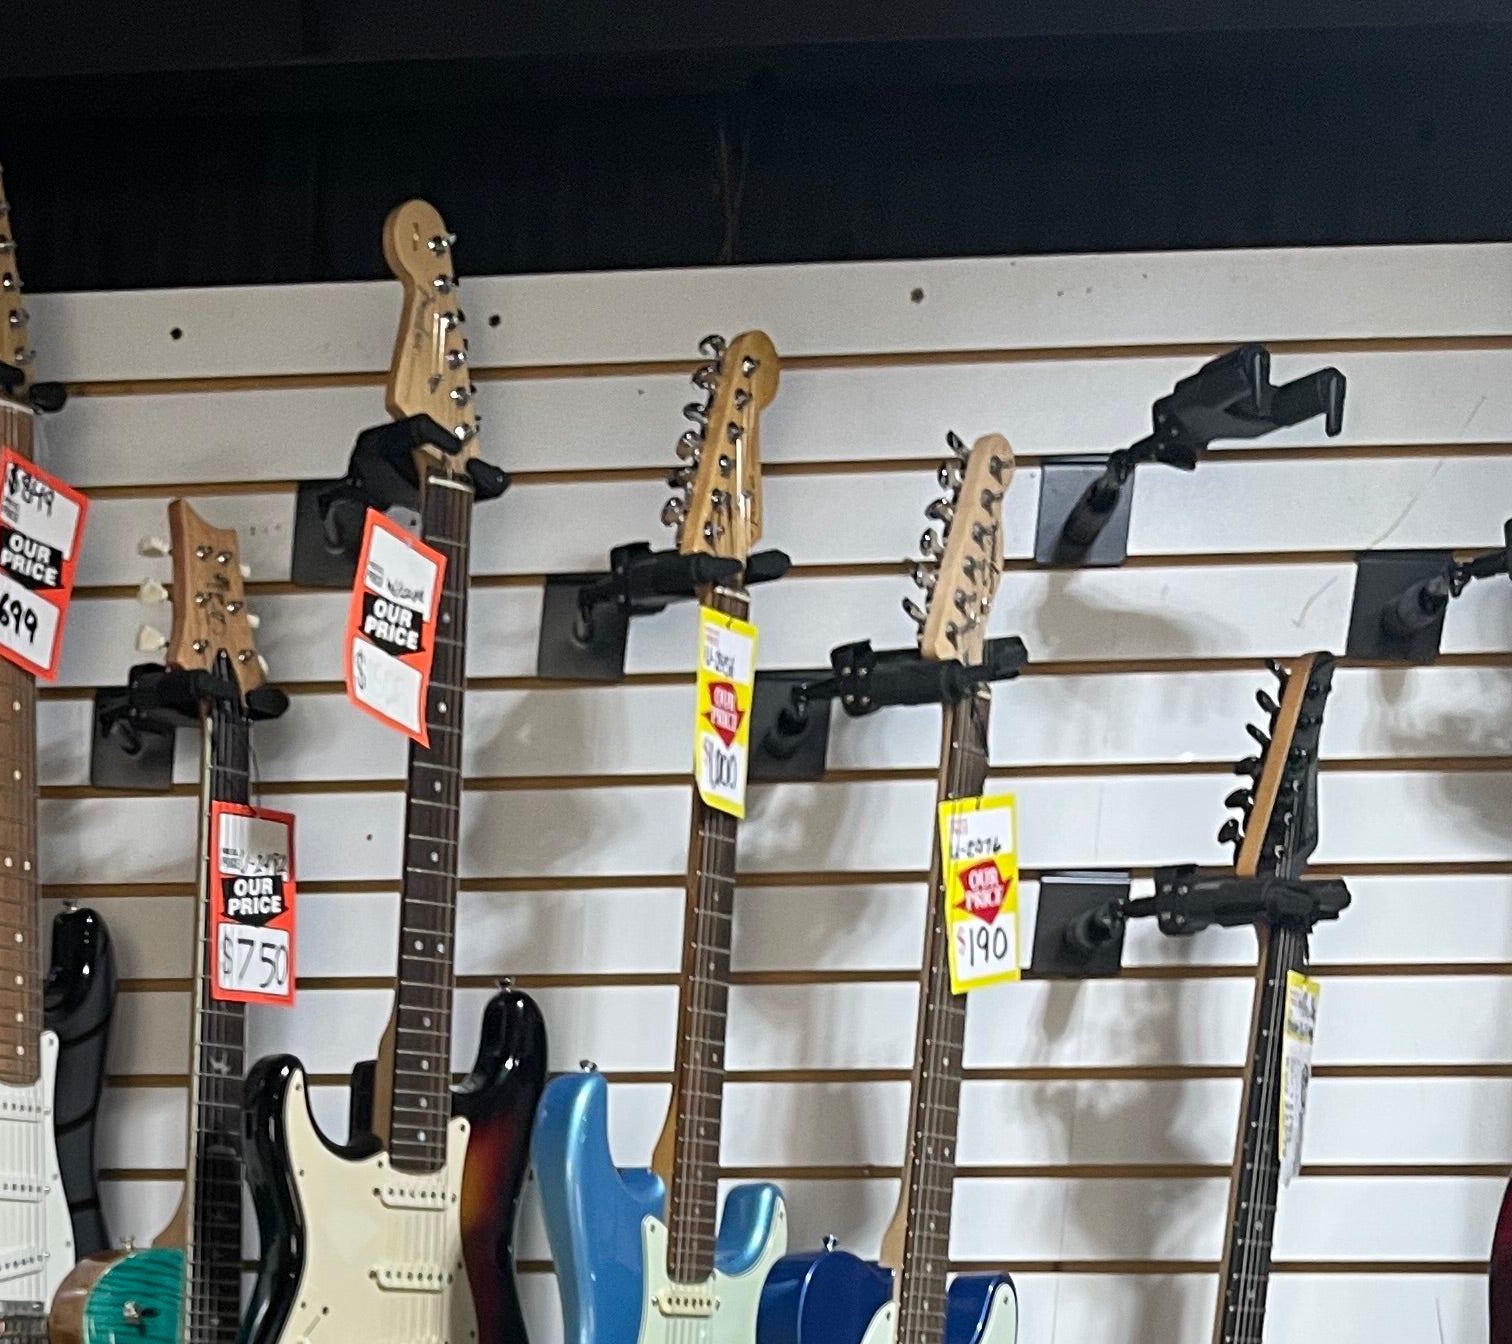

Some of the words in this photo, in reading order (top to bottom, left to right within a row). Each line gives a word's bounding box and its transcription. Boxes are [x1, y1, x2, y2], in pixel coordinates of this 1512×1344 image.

[8, 531, 52, 564] OUR
[0, 548, 59, 588] PRICE
[373, 597, 414, 629] OUR
[363, 614, 420, 652] PRICE
[233, 878, 274, 897] OUR
[227, 895, 283, 917] PRICE
[222, 928, 289, 989] $750
